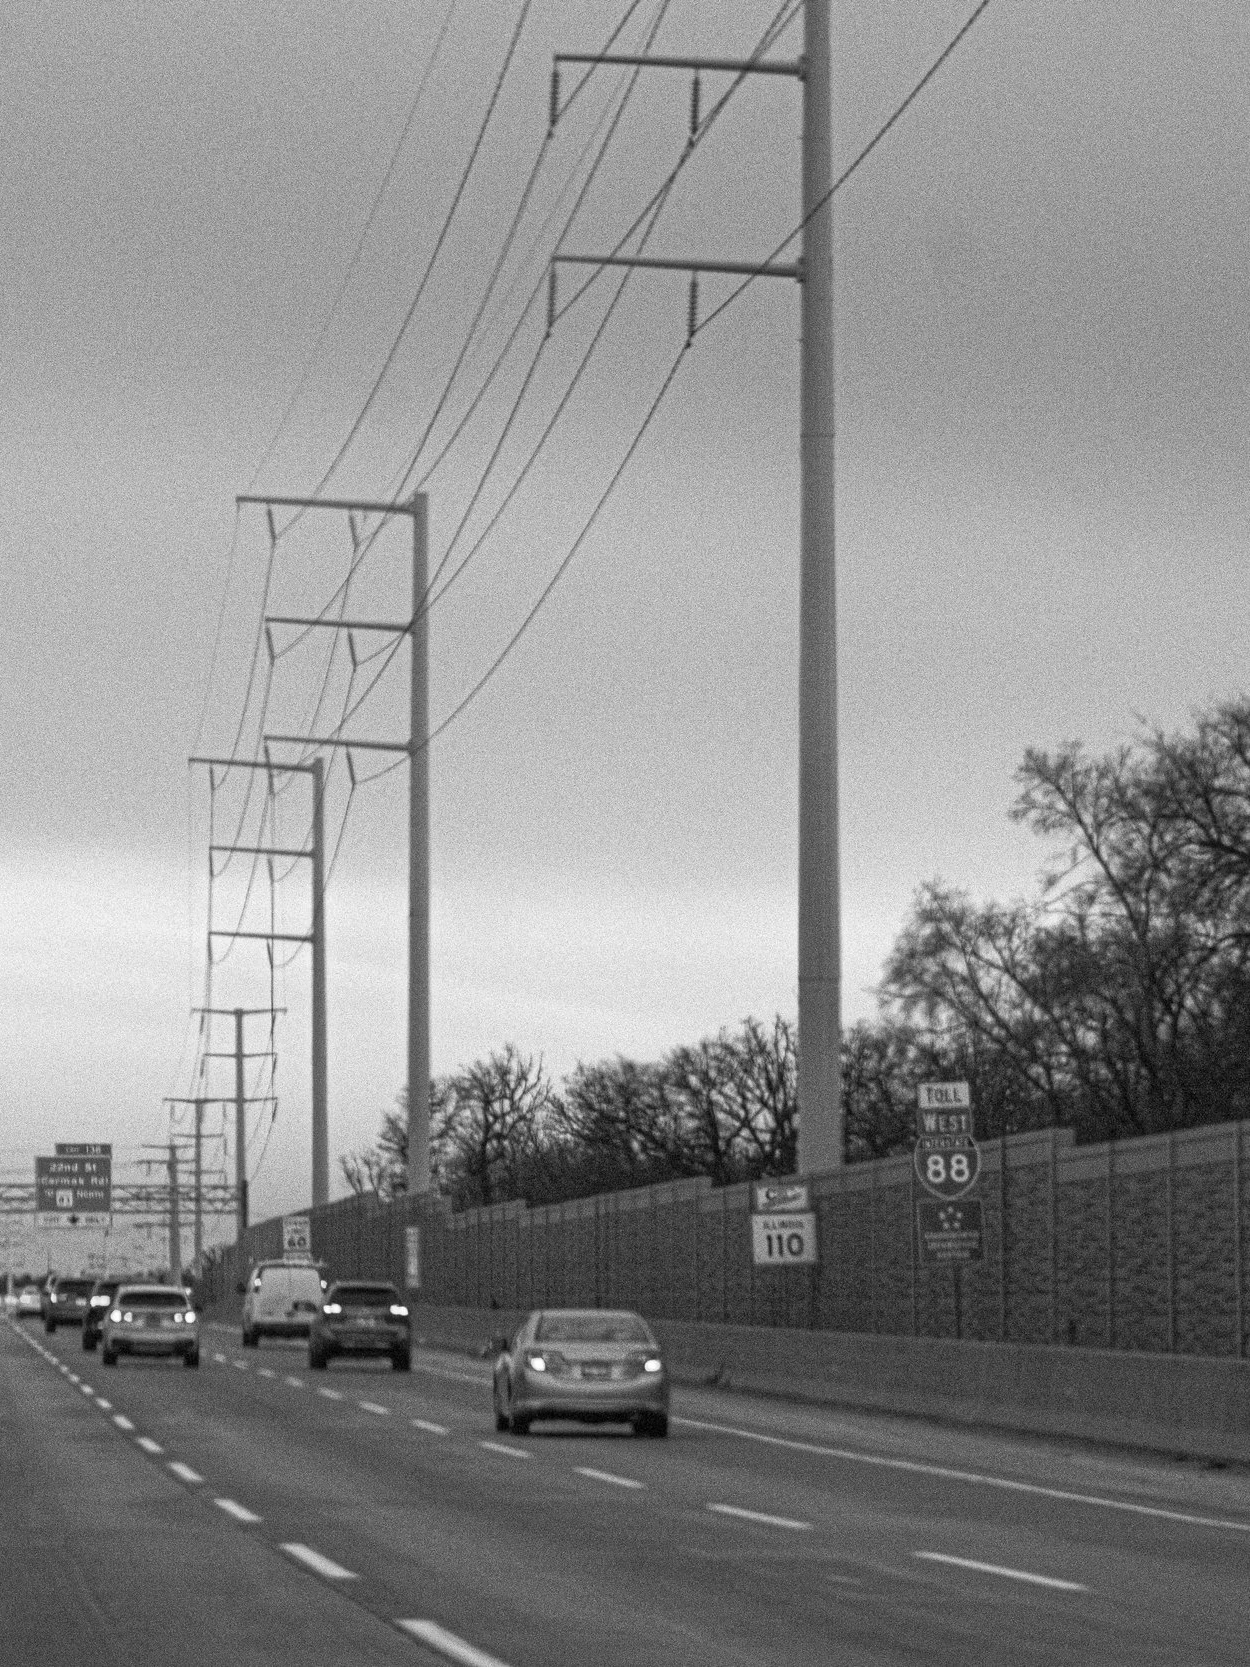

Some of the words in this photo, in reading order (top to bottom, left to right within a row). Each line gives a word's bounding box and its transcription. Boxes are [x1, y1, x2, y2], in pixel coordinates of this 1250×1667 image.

[925, 1086, 963, 1104] TOLL
[922, 1112, 968, 1133] WEST
[926, 1153, 970, 1184] 88
[766, 1232, 805, 1258] 110
